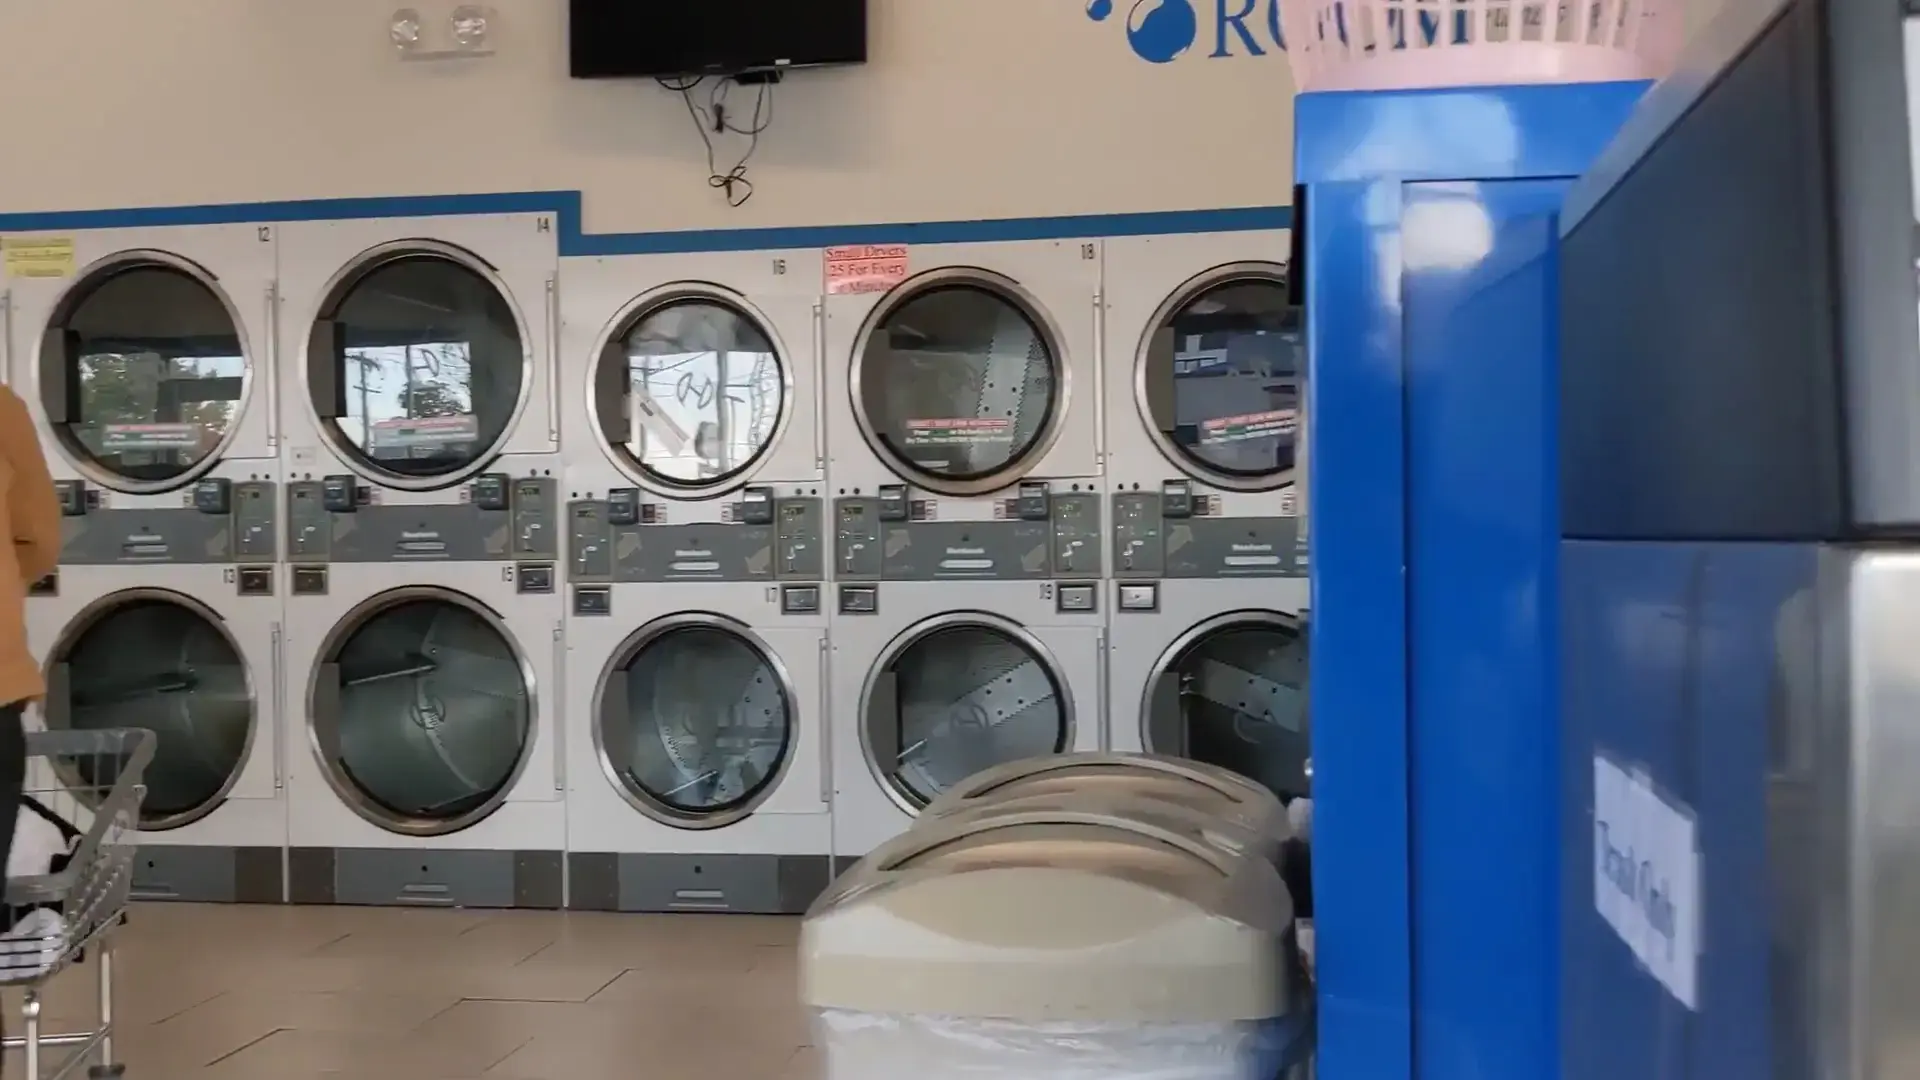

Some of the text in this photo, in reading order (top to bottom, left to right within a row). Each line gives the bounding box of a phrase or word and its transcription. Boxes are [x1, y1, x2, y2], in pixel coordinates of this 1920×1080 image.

[536, 216, 550, 233] 14
[257, 226, 270, 243] 12
[1081, 243, 1094, 260] 18
[848, 263, 869, 276] For
[871, 262, 906, 276] Every
[222, 567, 236, 584] 13
[501, 566, 514, 582] 15
